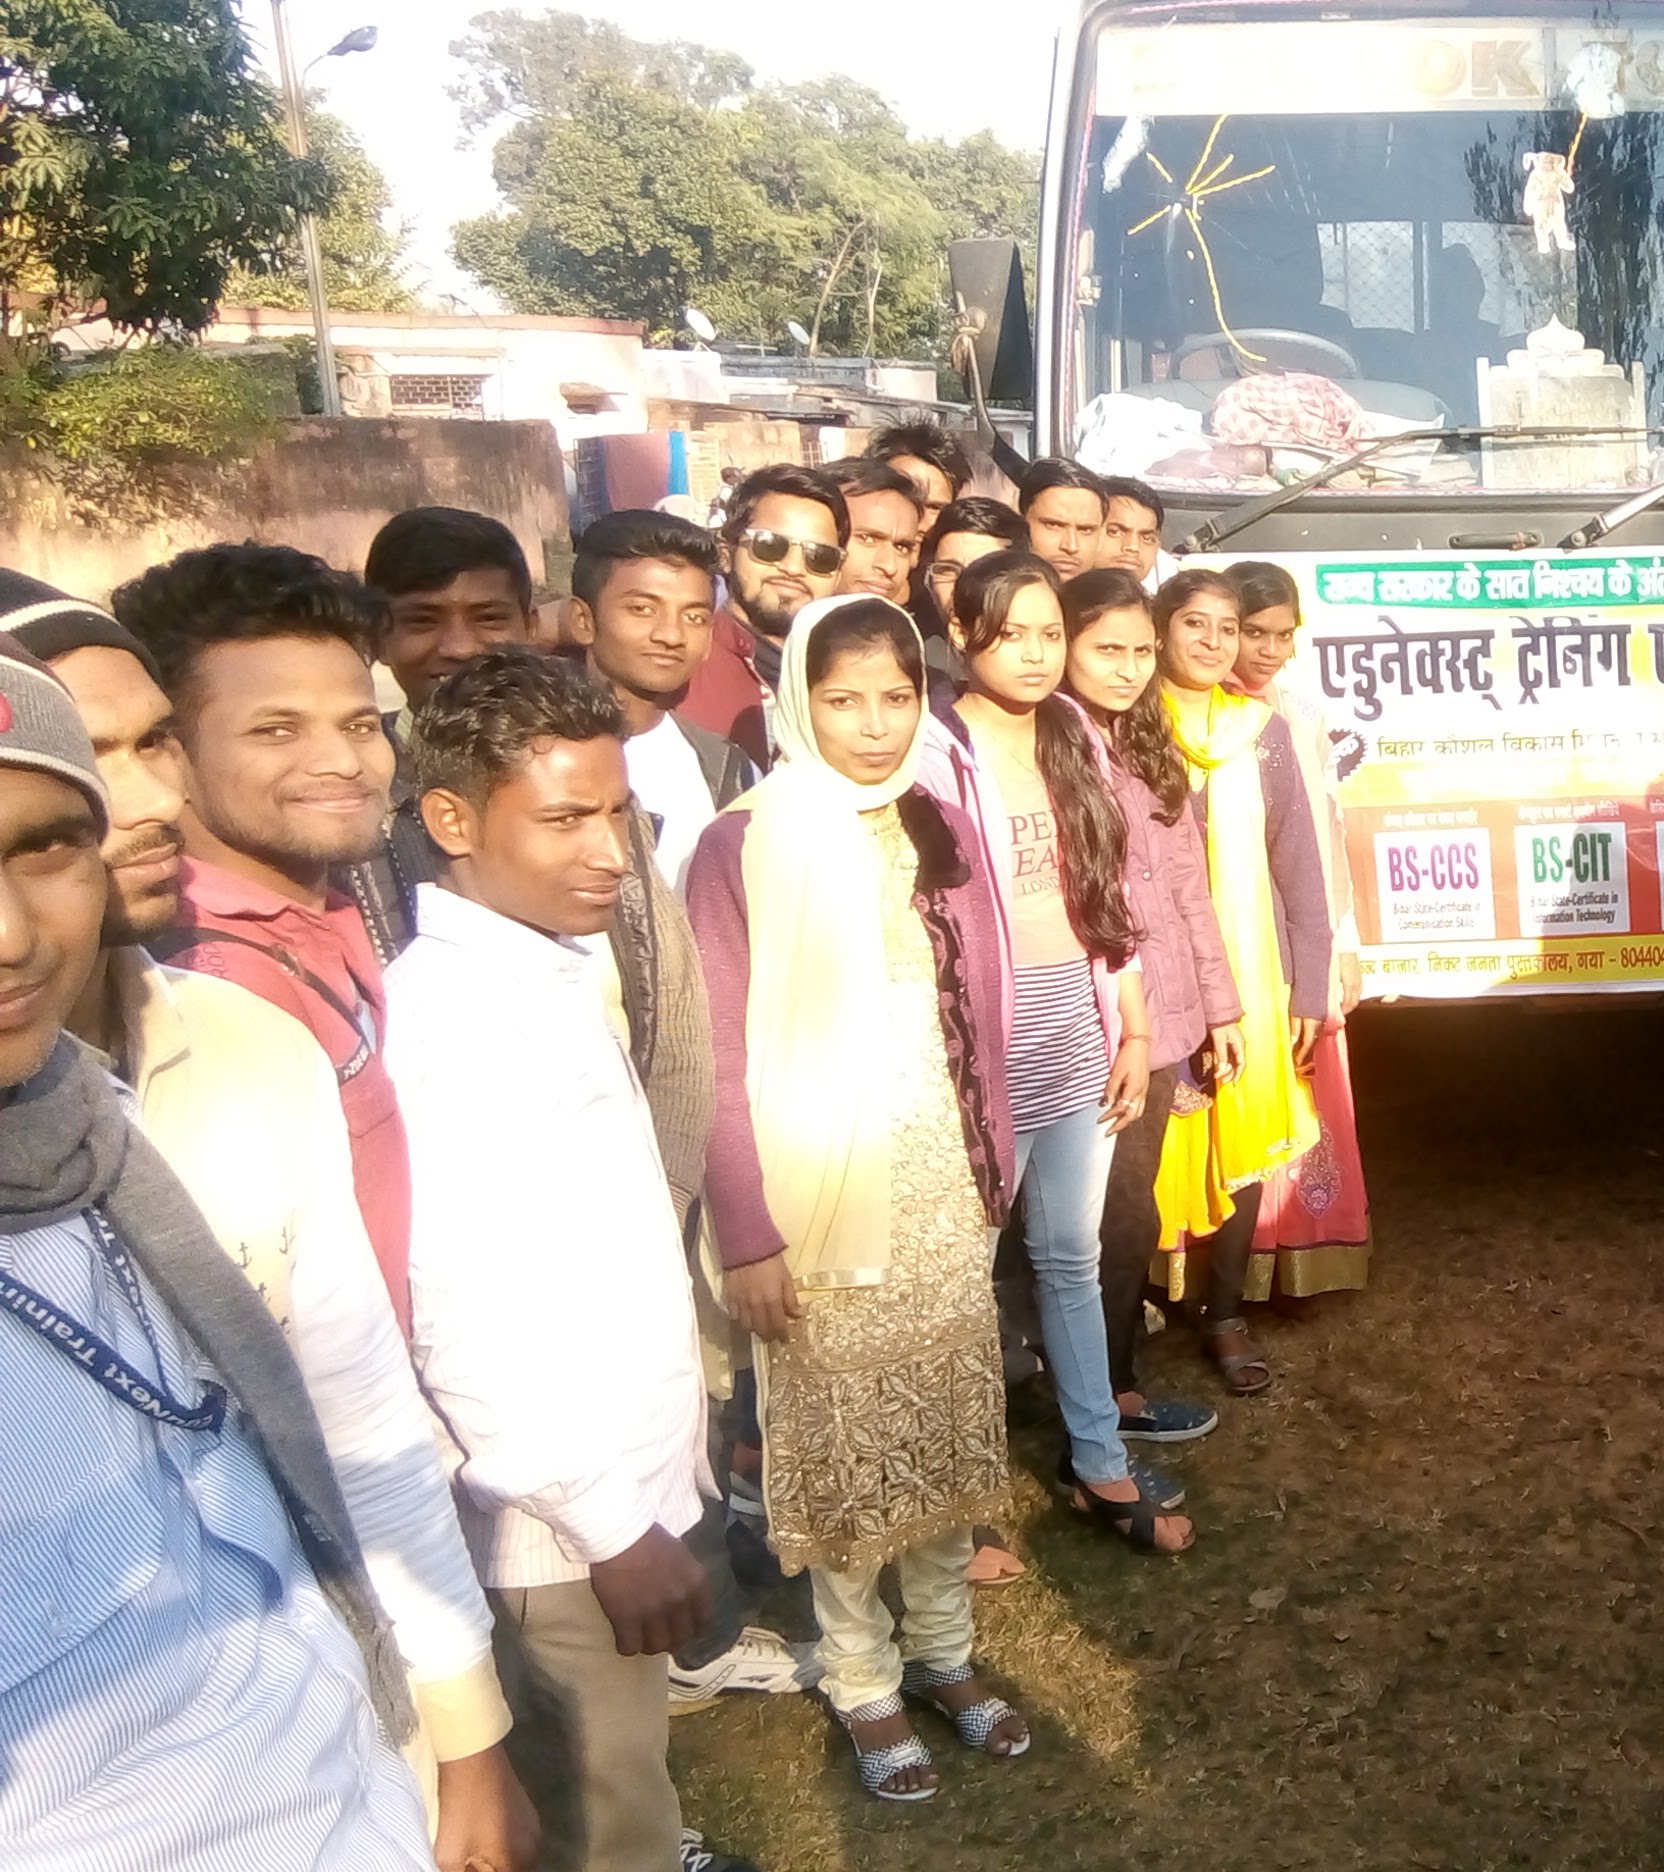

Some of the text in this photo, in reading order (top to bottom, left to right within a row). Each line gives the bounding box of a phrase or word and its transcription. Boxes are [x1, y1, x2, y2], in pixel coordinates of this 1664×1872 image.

[1455, 562, 1481, 601] के
[1483, 569, 1531, 600] सात
[1608, 559, 1633, 597] के
[1377, 735, 1425, 758] बिहार
[1388, 842, 1479, 892] BS-CCS
[1532, 832, 1612, 883] BS-CIT
[1575, 907, 1615, 924] Technology
[1577, 950, 1604, 969] गया
